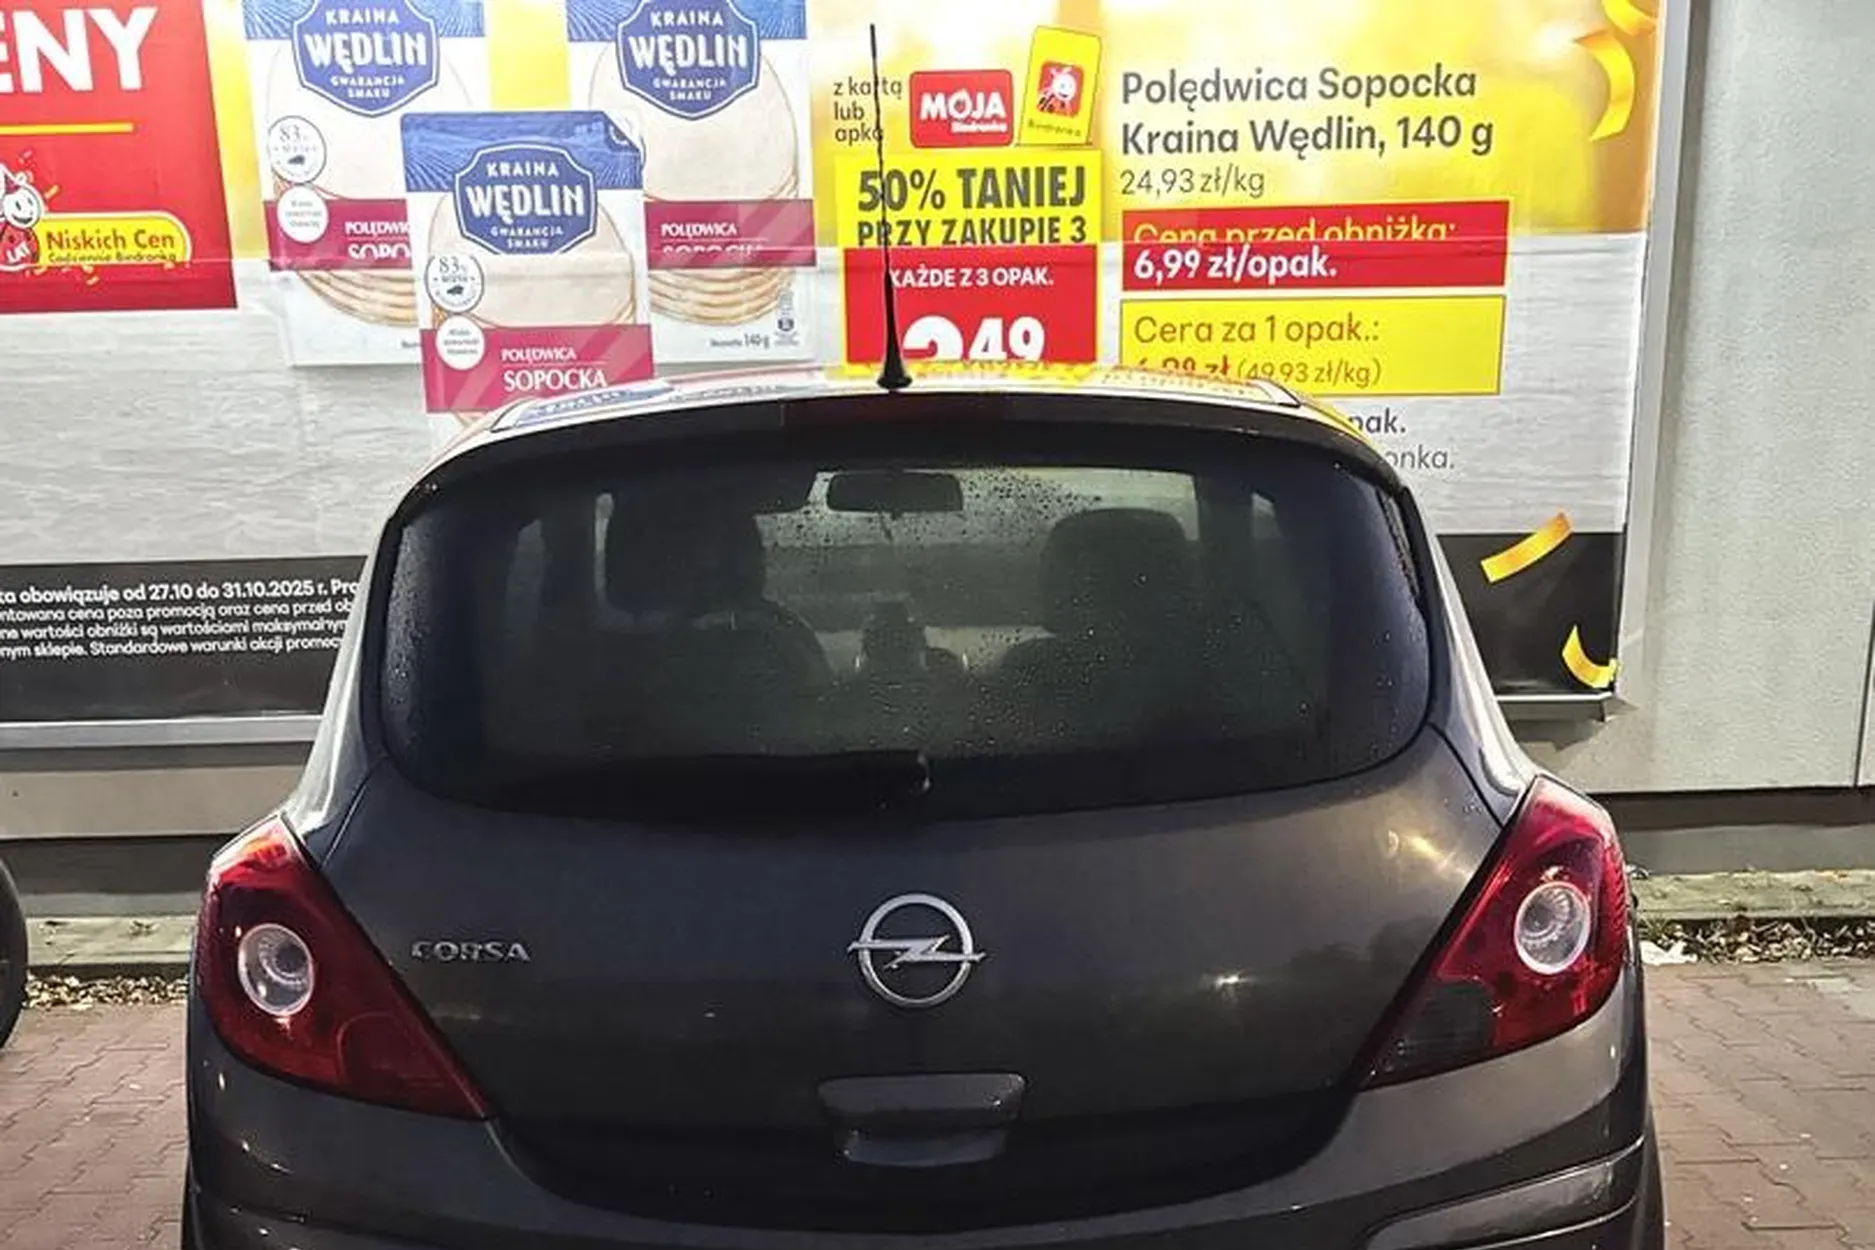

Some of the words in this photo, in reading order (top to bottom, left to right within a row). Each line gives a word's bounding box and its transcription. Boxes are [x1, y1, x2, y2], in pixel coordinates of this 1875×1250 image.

[325, 8, 399, 25] KRAINA
[650, 10, 723, 27] KRAINA
[303, 31, 427, 74] WĘDLIN
[628, 34, 748, 76] WĘDLIN
[330, 75, 405, 87] GWARANCJA
[652, 78, 727, 89] GWARANCJA
[834, 82, 843, 96] z
[848, 77, 902, 100] katą
[1122, 67, 1307, 112] Polędwica
[1318, 63, 1477, 107] Sopocka
[834, 101, 864, 120] lub
[919, 88, 1007, 120] MOJA
[1122, 122, 1239, 155] Kraina
[1250, 116, 1385, 160] Wędlin,
[1397, 115, 1461, 149] 140
[1472, 119, 1493, 155] g
[487, 161, 560, 177] KRAINA
[1121, 167, 1195, 198] 24,93
[1200, 163, 1265, 197] zł/kg
[858, 169, 946, 213] 50%
[956, 166, 1086, 210] TANIEJ
[465, 184, 585, 224] WĘDLIN
[46, 229, 126, 250] Niskich
[134, 229, 175, 249] Cen
[491, 226, 564, 237] GWARANCJA
[661, 222, 737, 240] POLĘDWICA
[858, 220, 932, 247] PRZY
[942, 217, 1061, 245] ZAKUPIE
[1070, 215, 1087, 243] 3
[1134, 249, 1201, 285] 6,99
[1207, 243, 1338, 285] zł/opak.
[960, 269, 972, 287] Z
[976, 268, 988, 287] 3
[992, 266, 1054, 286] OPAK.
[1222, 321, 1256, 343] za
[1265, 316, 1275, 342] 1
[1285, 312, 1379, 348] opak.:
[502, 348, 576, 363] POLĘDWICA
[504, 368, 607, 391] SOPOCKA
[19, 585, 120, 606] obowiązuje
[123, 583, 146, 600] od
[148, 583, 193, 600] 27.10
[196, 582, 219, 599] do
[221, 580, 315, 599] 31.10.2025
[317, 582, 328, 596] r.
[67, 608, 104, 620] cena
[107, 607, 144, 622] poza
[218, 604, 250, 616] oraz
[253, 602, 290, 615] cena
[292, 598, 332, 617] przed
[90, 639, 189, 656] Standardowe
[411, 941, 531, 961] CORSA
